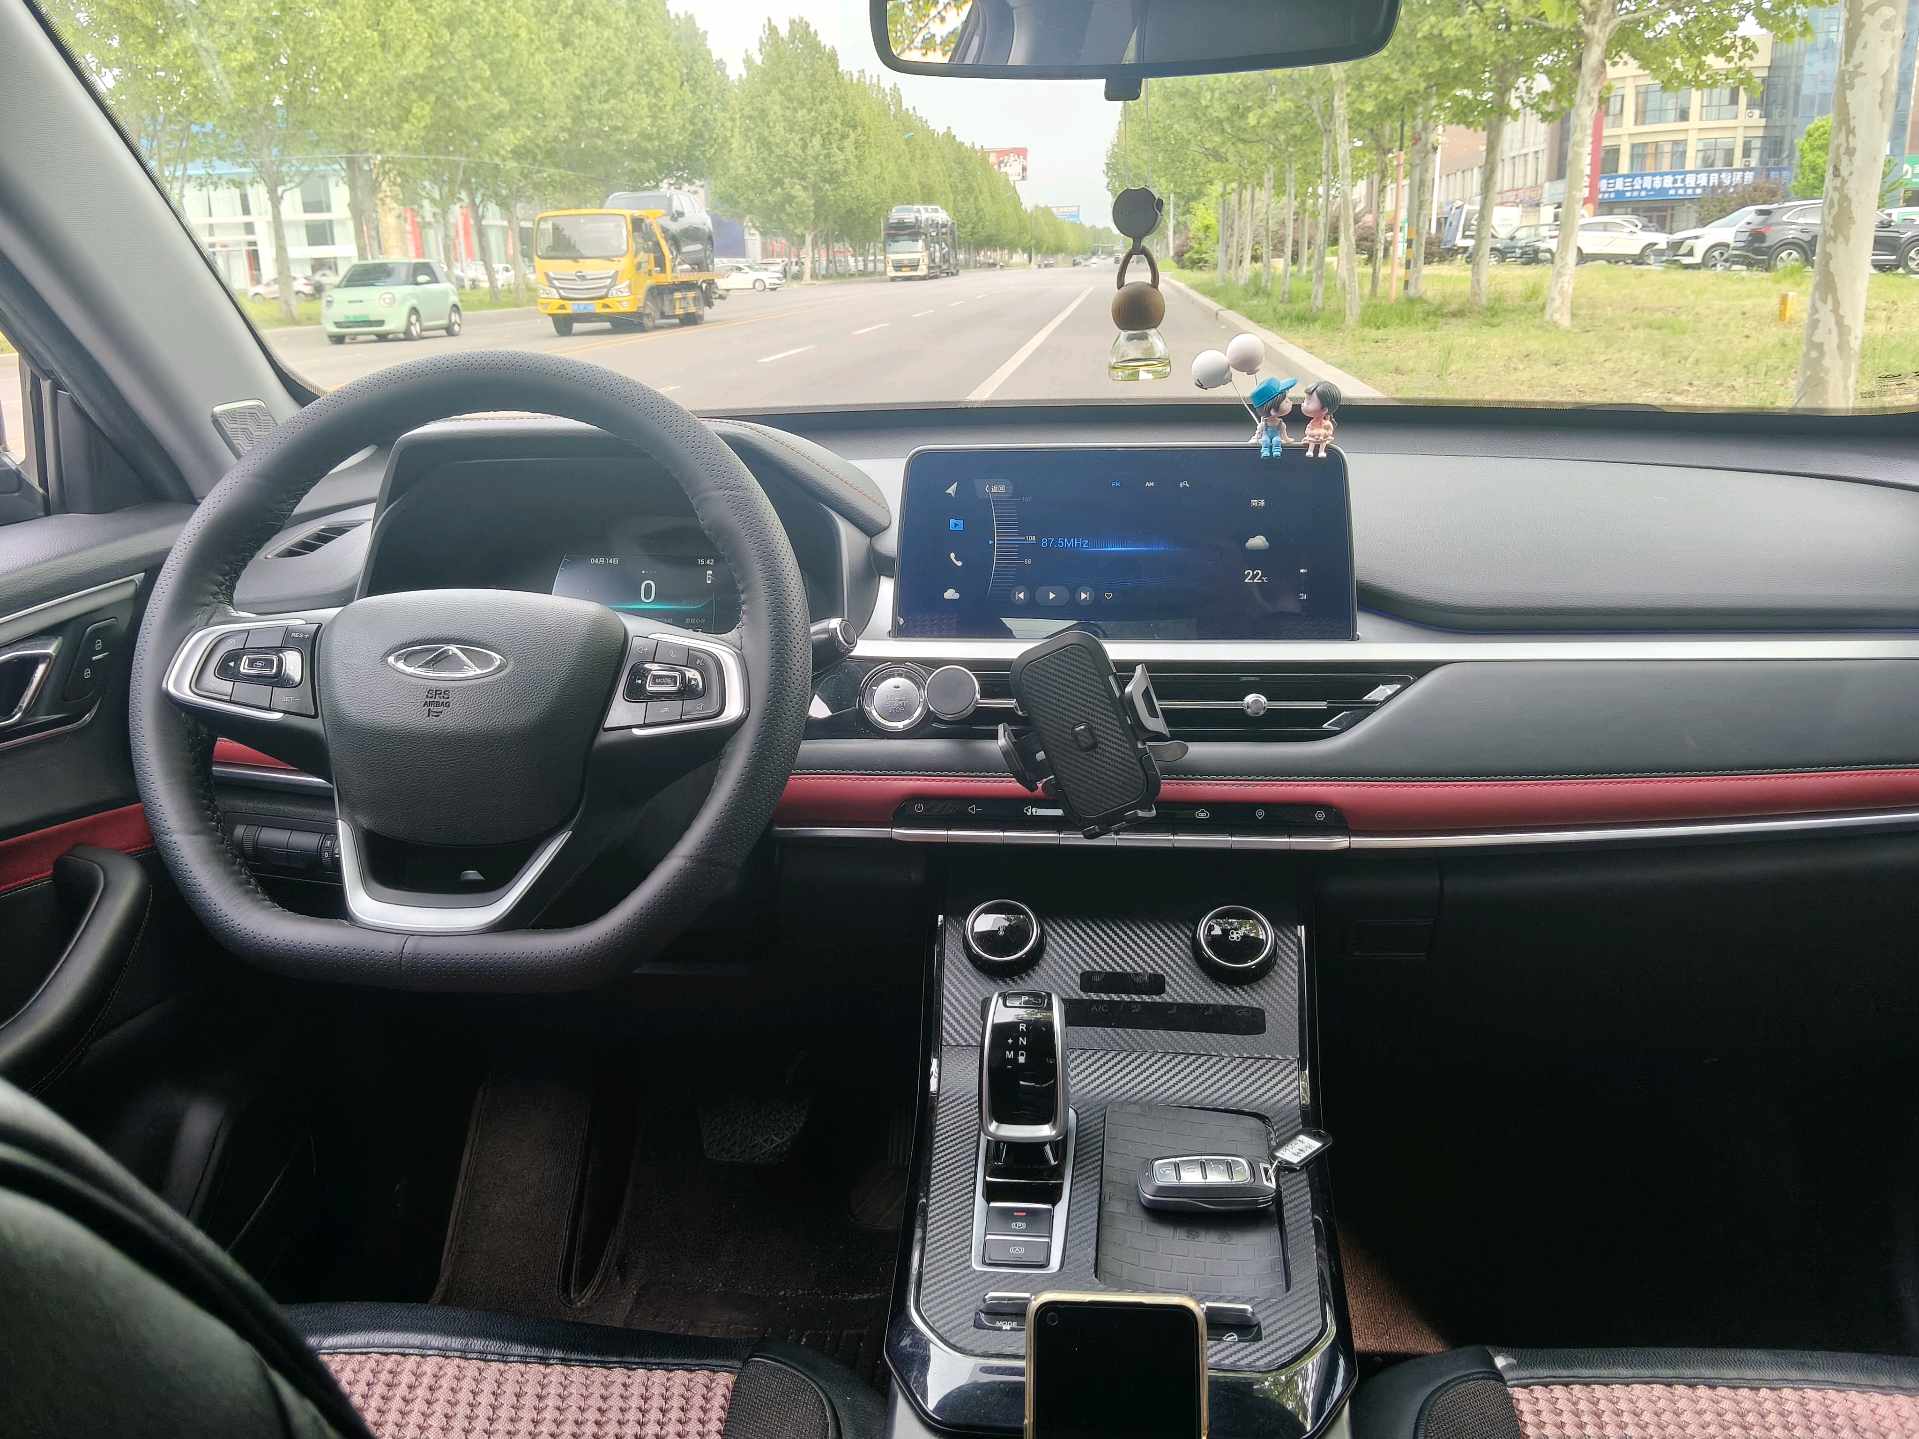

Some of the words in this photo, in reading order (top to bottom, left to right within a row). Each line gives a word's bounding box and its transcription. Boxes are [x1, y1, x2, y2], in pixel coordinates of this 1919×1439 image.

[1041, 537, 1089, 548] 87.5MHz
[640, 580, 656, 602] 0
[426, 689, 450, 700] SRS
[423, 700, 450, 708] AIRBAG
[1019, 1023, 1027, 1032] R
[1018, 1036, 1027, 1045] N
[1005, 1050, 1014, 1060] M
